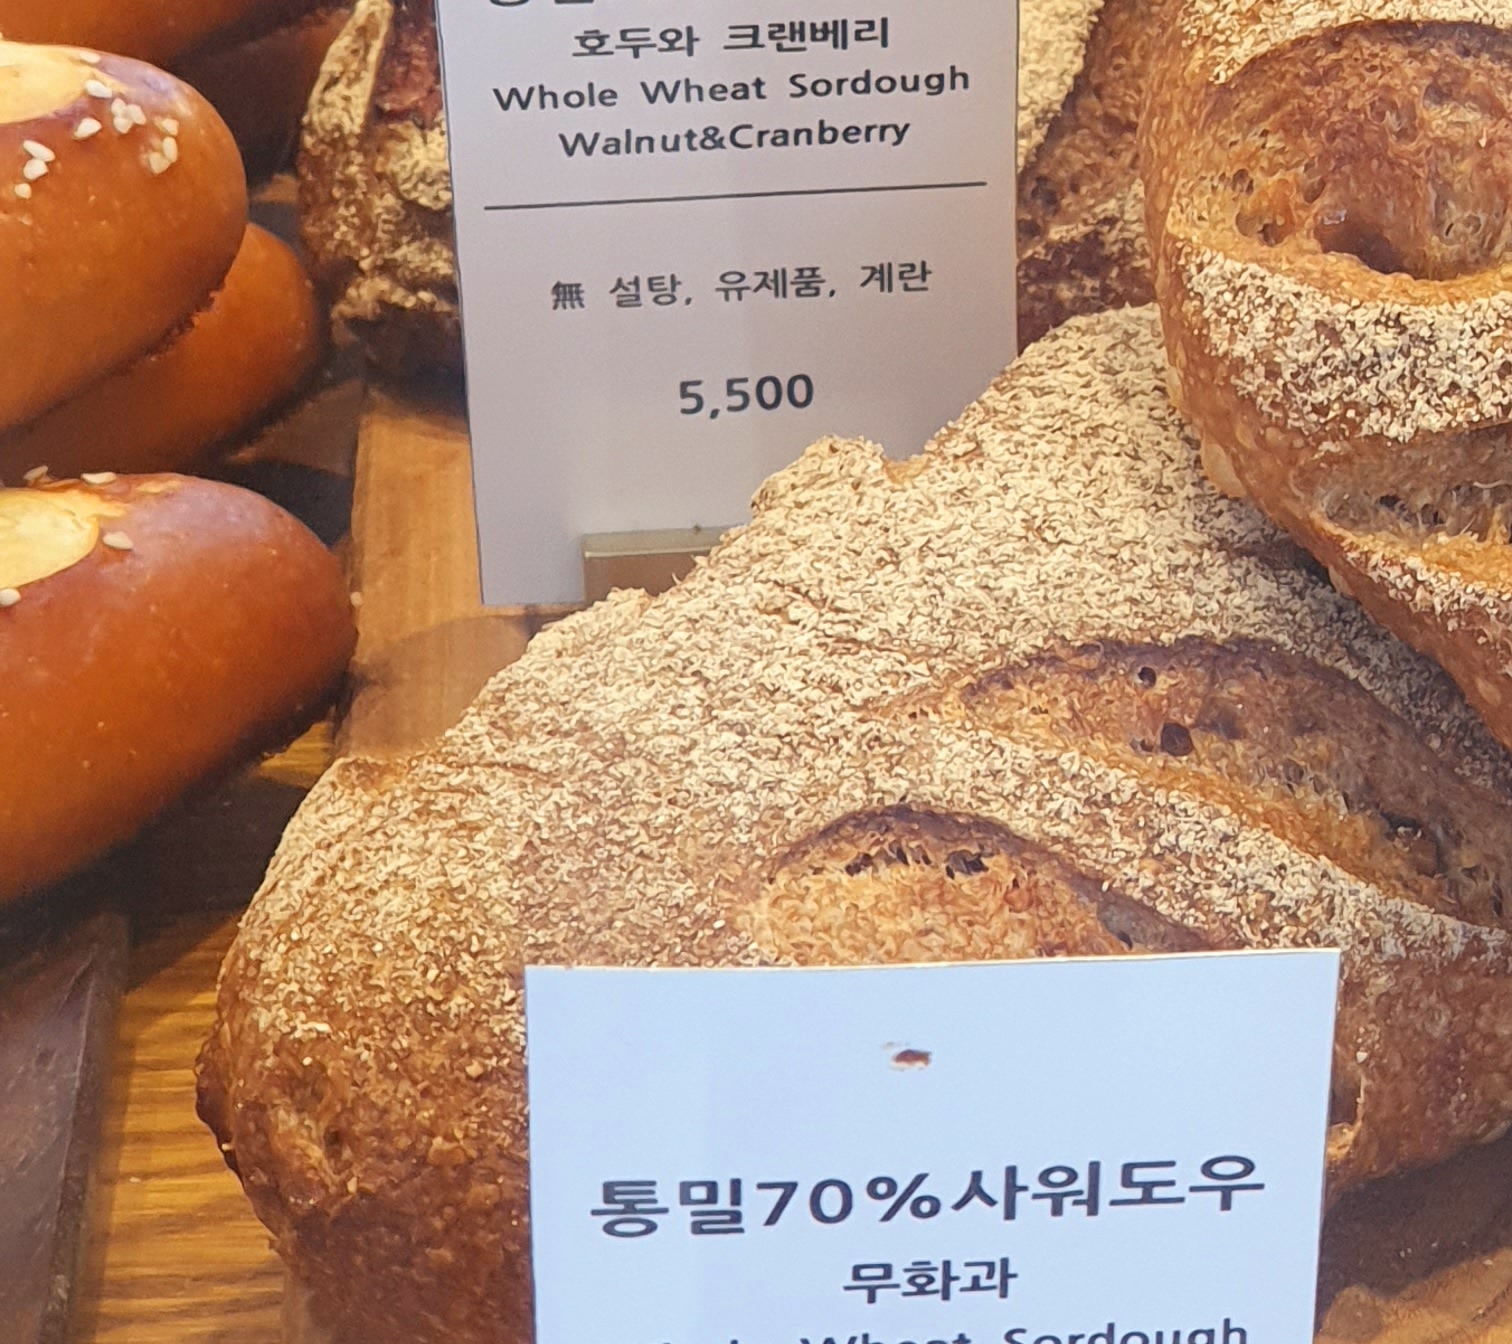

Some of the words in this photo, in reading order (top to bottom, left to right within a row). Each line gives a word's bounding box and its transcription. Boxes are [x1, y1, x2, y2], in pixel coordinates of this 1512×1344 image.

[571, 25, 701, 60] 호두와
[723, 16, 889, 53] 크랜베리
[492, 81, 618, 112] Whole
[639, 76, 767, 105] Wheat
[788, 64, 969, 99] Sordough
[558, 118, 911, 158] Walnut&Cranberry
[609, 273, 692, 309] 설탕,
[715, 266, 836, 302] 유제품,
[859, 259, 933, 294] 계란
[679, 373, 814, 420] 5,500
[590, 1155, 1266, 1239] 통밀70%사워도우
[842, 1256, 1019, 1305] 무화과
